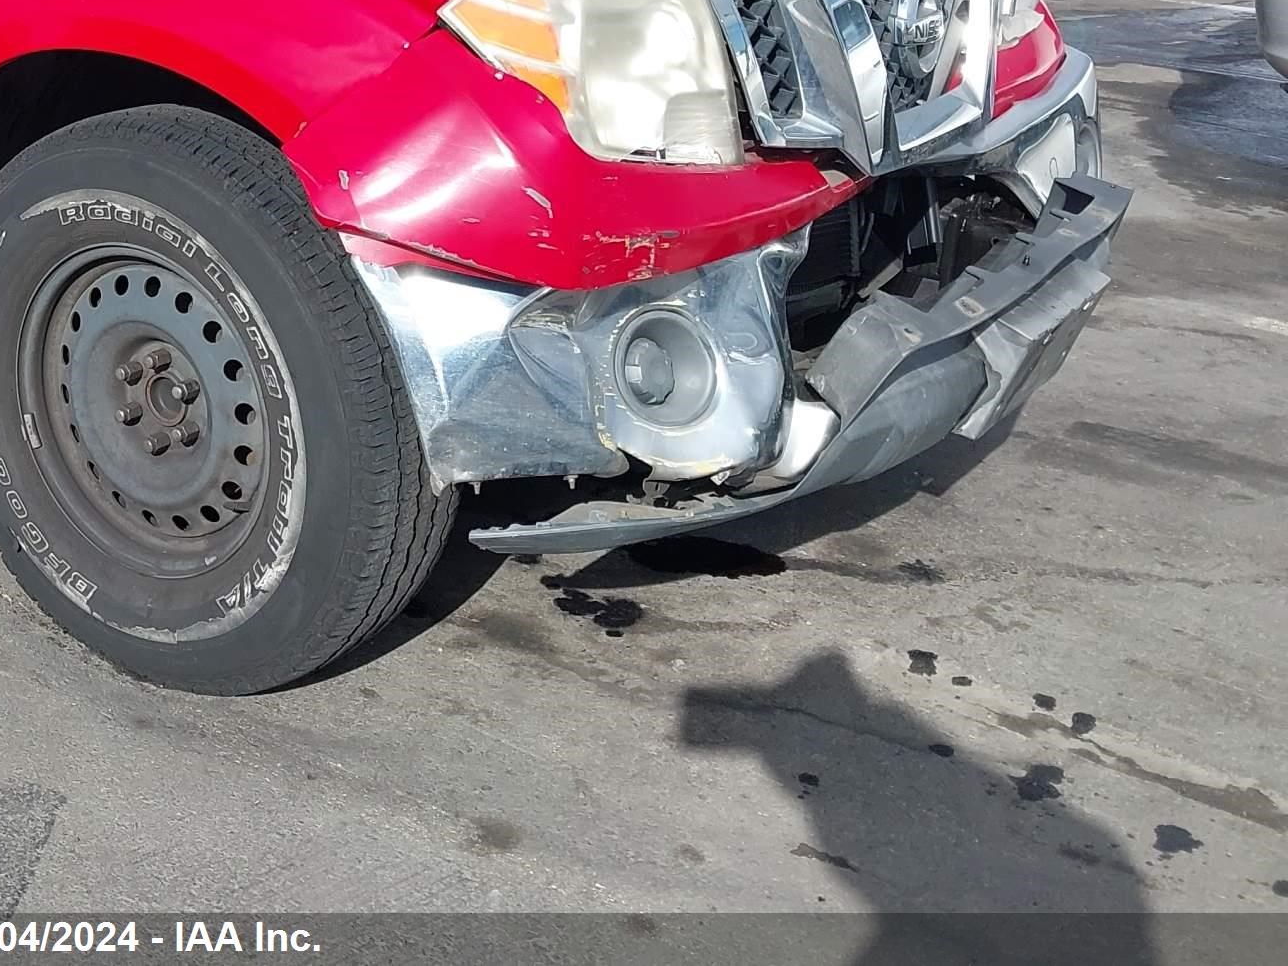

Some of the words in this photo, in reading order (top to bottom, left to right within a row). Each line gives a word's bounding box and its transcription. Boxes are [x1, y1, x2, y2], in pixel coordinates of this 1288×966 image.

[57, 202, 198, 259] Radial
[204, 262, 283, 400] Long
[267, 415, 294, 558] Trail
[216, 558, 271, 616] T/A
